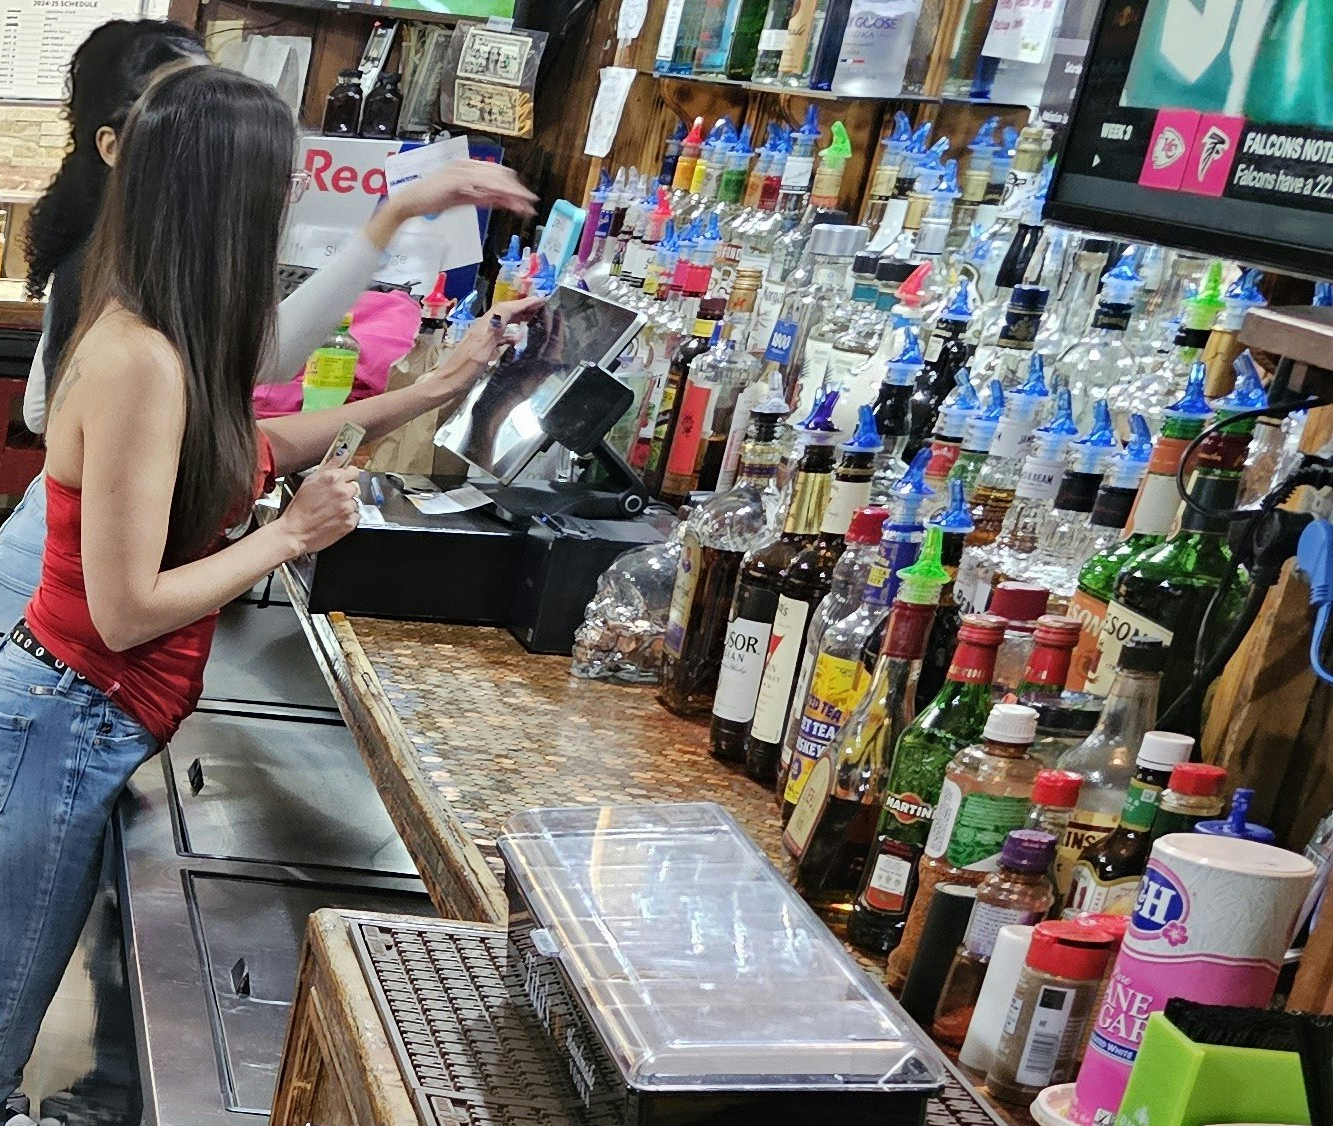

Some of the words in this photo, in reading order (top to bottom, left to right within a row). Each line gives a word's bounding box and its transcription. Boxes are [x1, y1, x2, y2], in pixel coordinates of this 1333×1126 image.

[1100, 122, 1124, 140] WEEK
[1243, 131, 1304, 159] FALCONS
[1233, 163, 1276, 190] Falcons
[1275, 169, 1304, 193] have
[1303, 177, 1314, 195] a
[772, 332, 792, 350] 1800
[821, 700, 843, 723] TEA
[812, 721, 836, 741] TEA
[1107, 1041, 1134, 1060] WHITE
